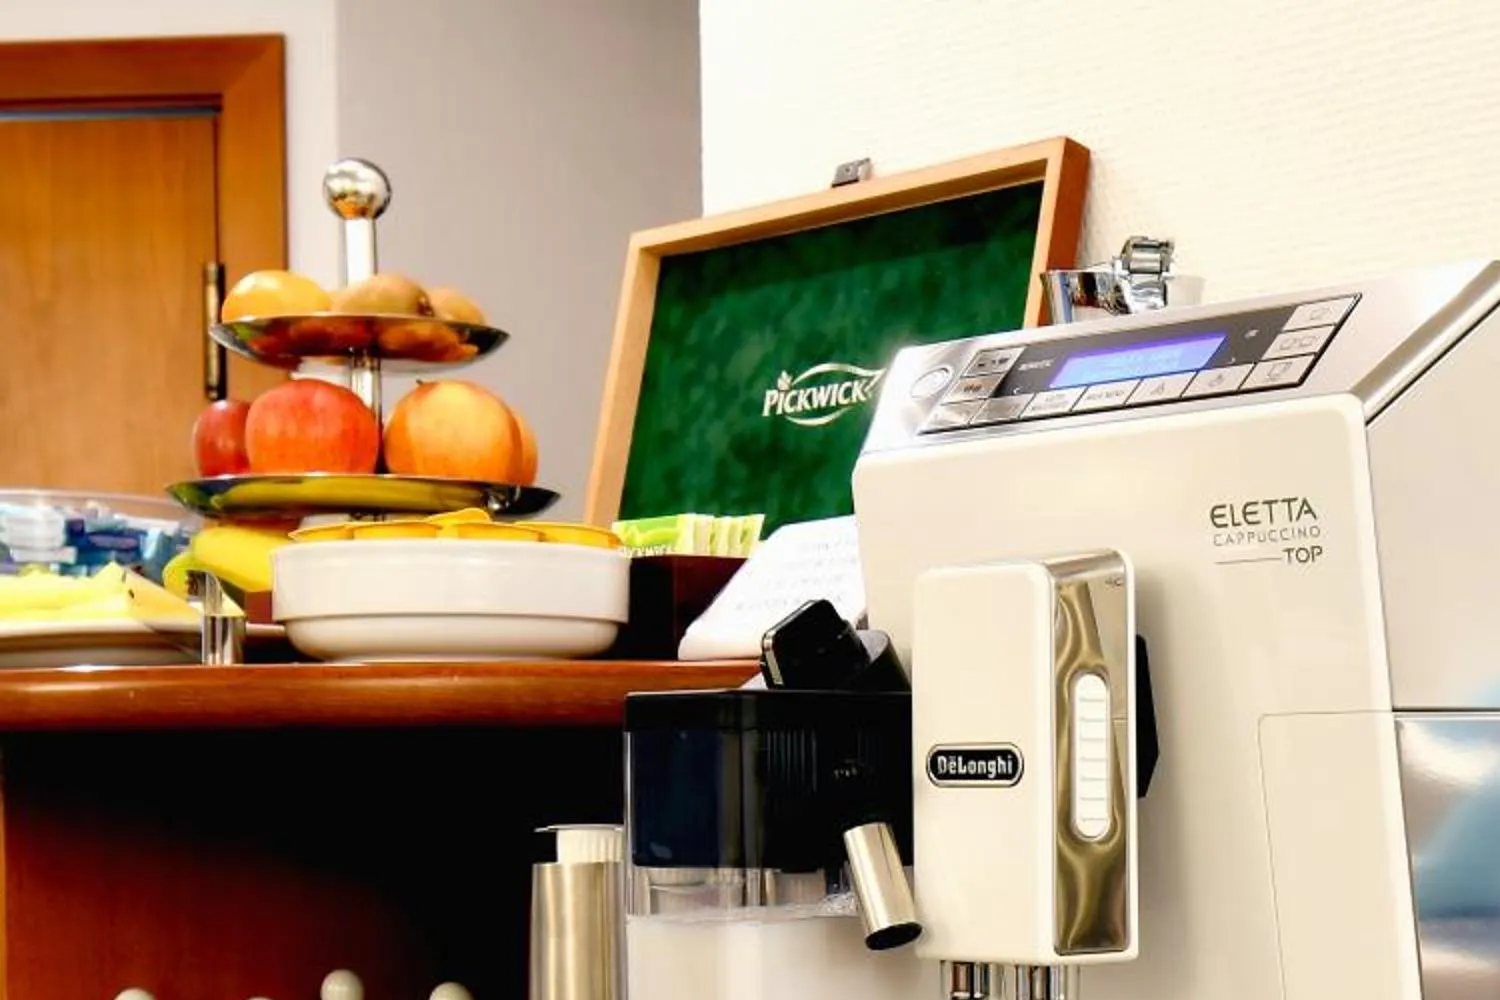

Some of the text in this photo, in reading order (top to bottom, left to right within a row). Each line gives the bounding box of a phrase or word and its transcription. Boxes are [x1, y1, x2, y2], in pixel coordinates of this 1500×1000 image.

[763, 377, 869, 417] PICKWICK
[1209, 497, 1318, 529] ELETTA
[1213, 525, 1321, 546] CAPPUCCINO
[1282, 545, 1324, 564] TOP
